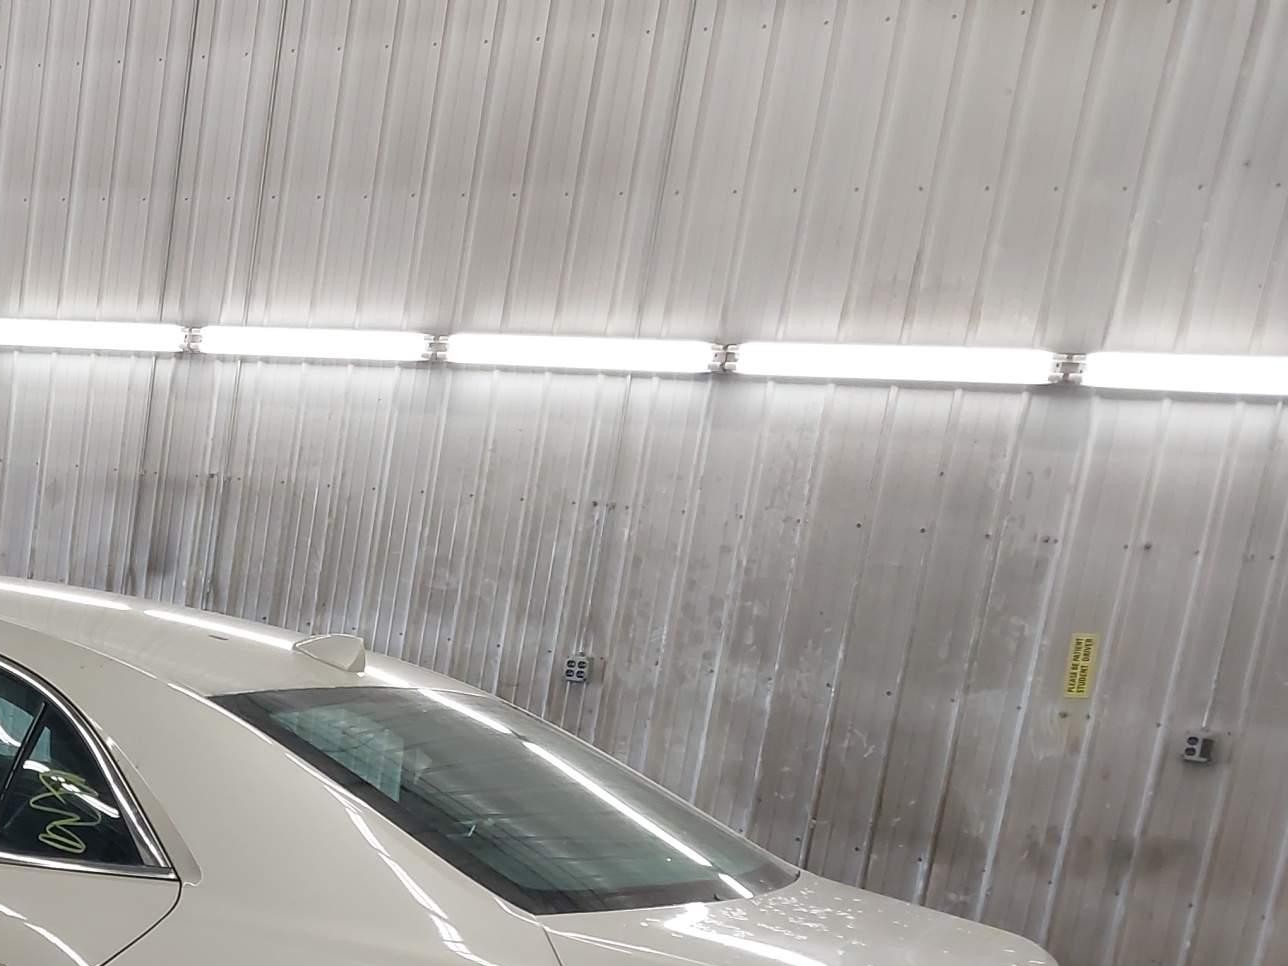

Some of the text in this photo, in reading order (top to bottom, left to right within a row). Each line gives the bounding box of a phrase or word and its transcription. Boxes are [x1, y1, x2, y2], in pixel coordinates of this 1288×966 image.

[1072, 638, 1084, 661] PATIENT
[1076, 638, 1094, 693] STUDENT DRIVER
[1067, 672, 1078, 693] PLEASE
